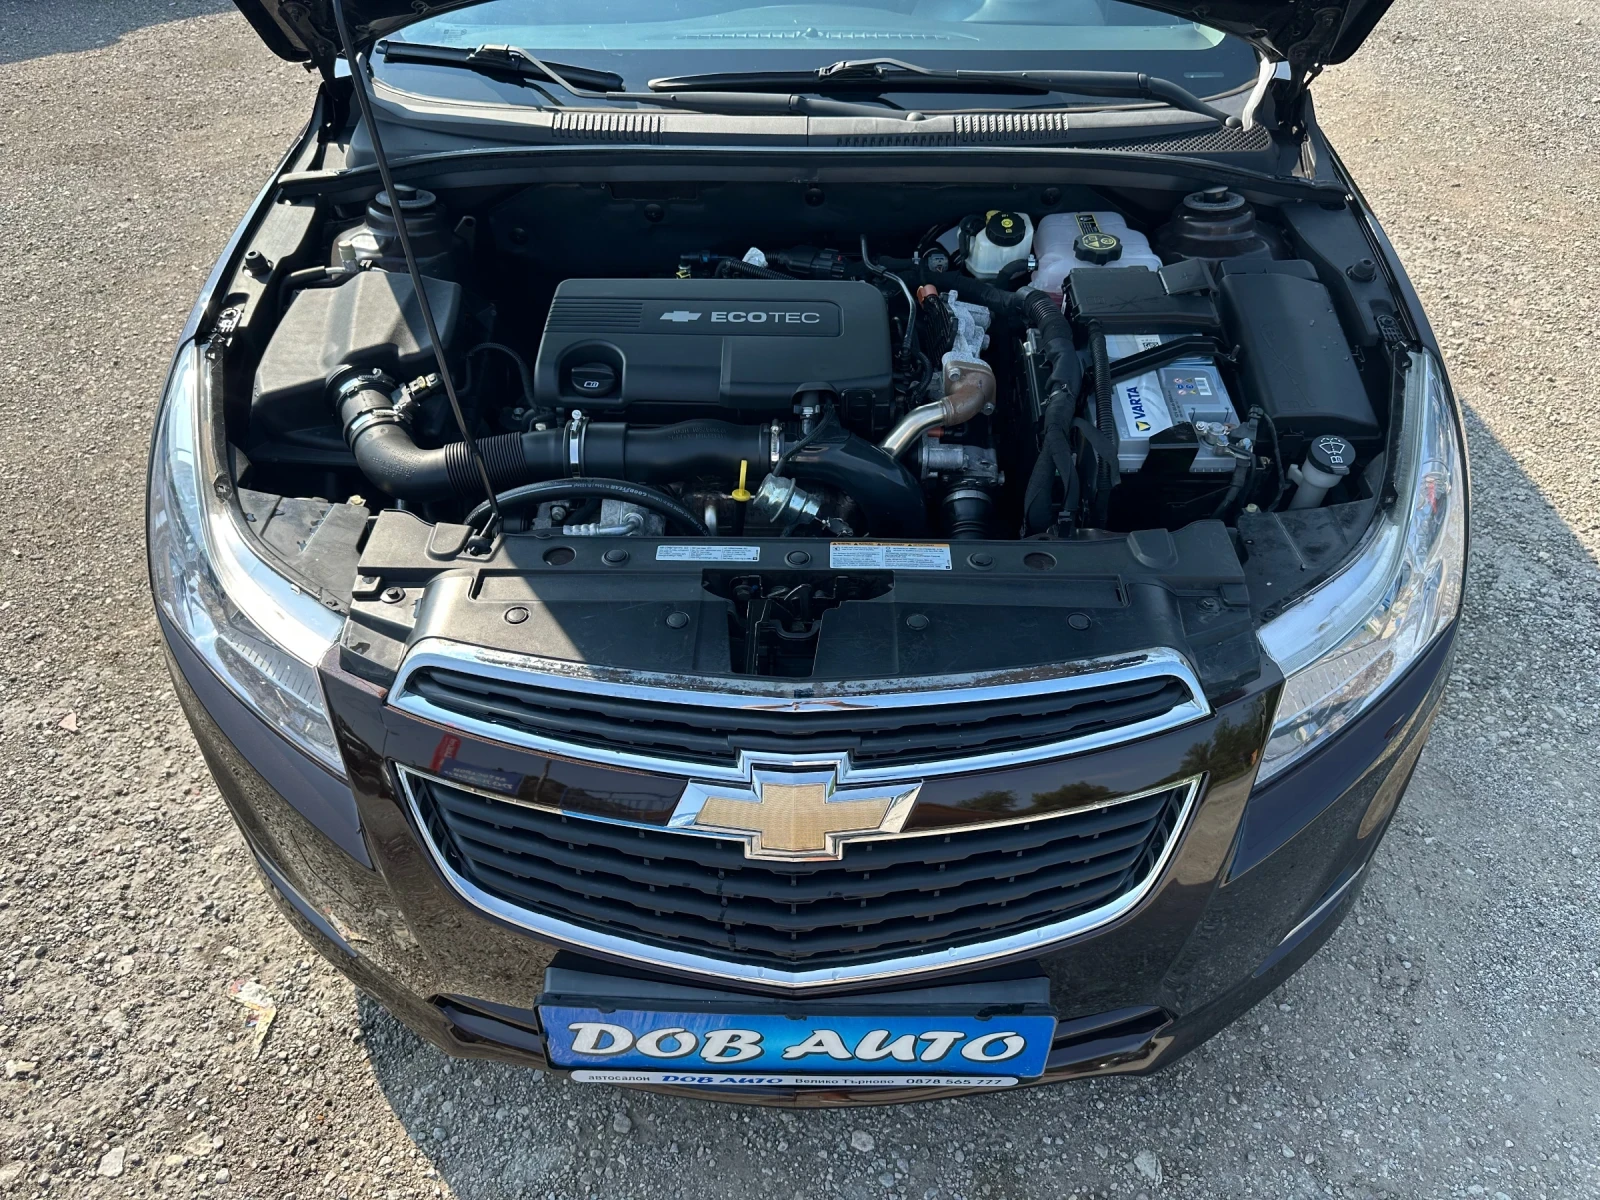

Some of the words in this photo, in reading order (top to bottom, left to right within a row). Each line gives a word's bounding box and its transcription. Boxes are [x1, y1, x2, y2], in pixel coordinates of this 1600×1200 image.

[710, 311, 821, 324] ECOTEC
[1126, 386, 1146, 420] VARTA
[610, 484, 648, 497] GOODYEAR
[567, 1021, 765, 1064] DOB
[781, 1028, 1029, 1064] AUTO
[588, 1073, 651, 1082] автосалон
[661, 1075, 714, 1084] DOB
[719, 1076, 783, 1085] AUTO
[795, 1077, 839, 1085] Велико
[841, 1077, 895, 1086] Търново
[976, 1078, 1002, 1086] 777
